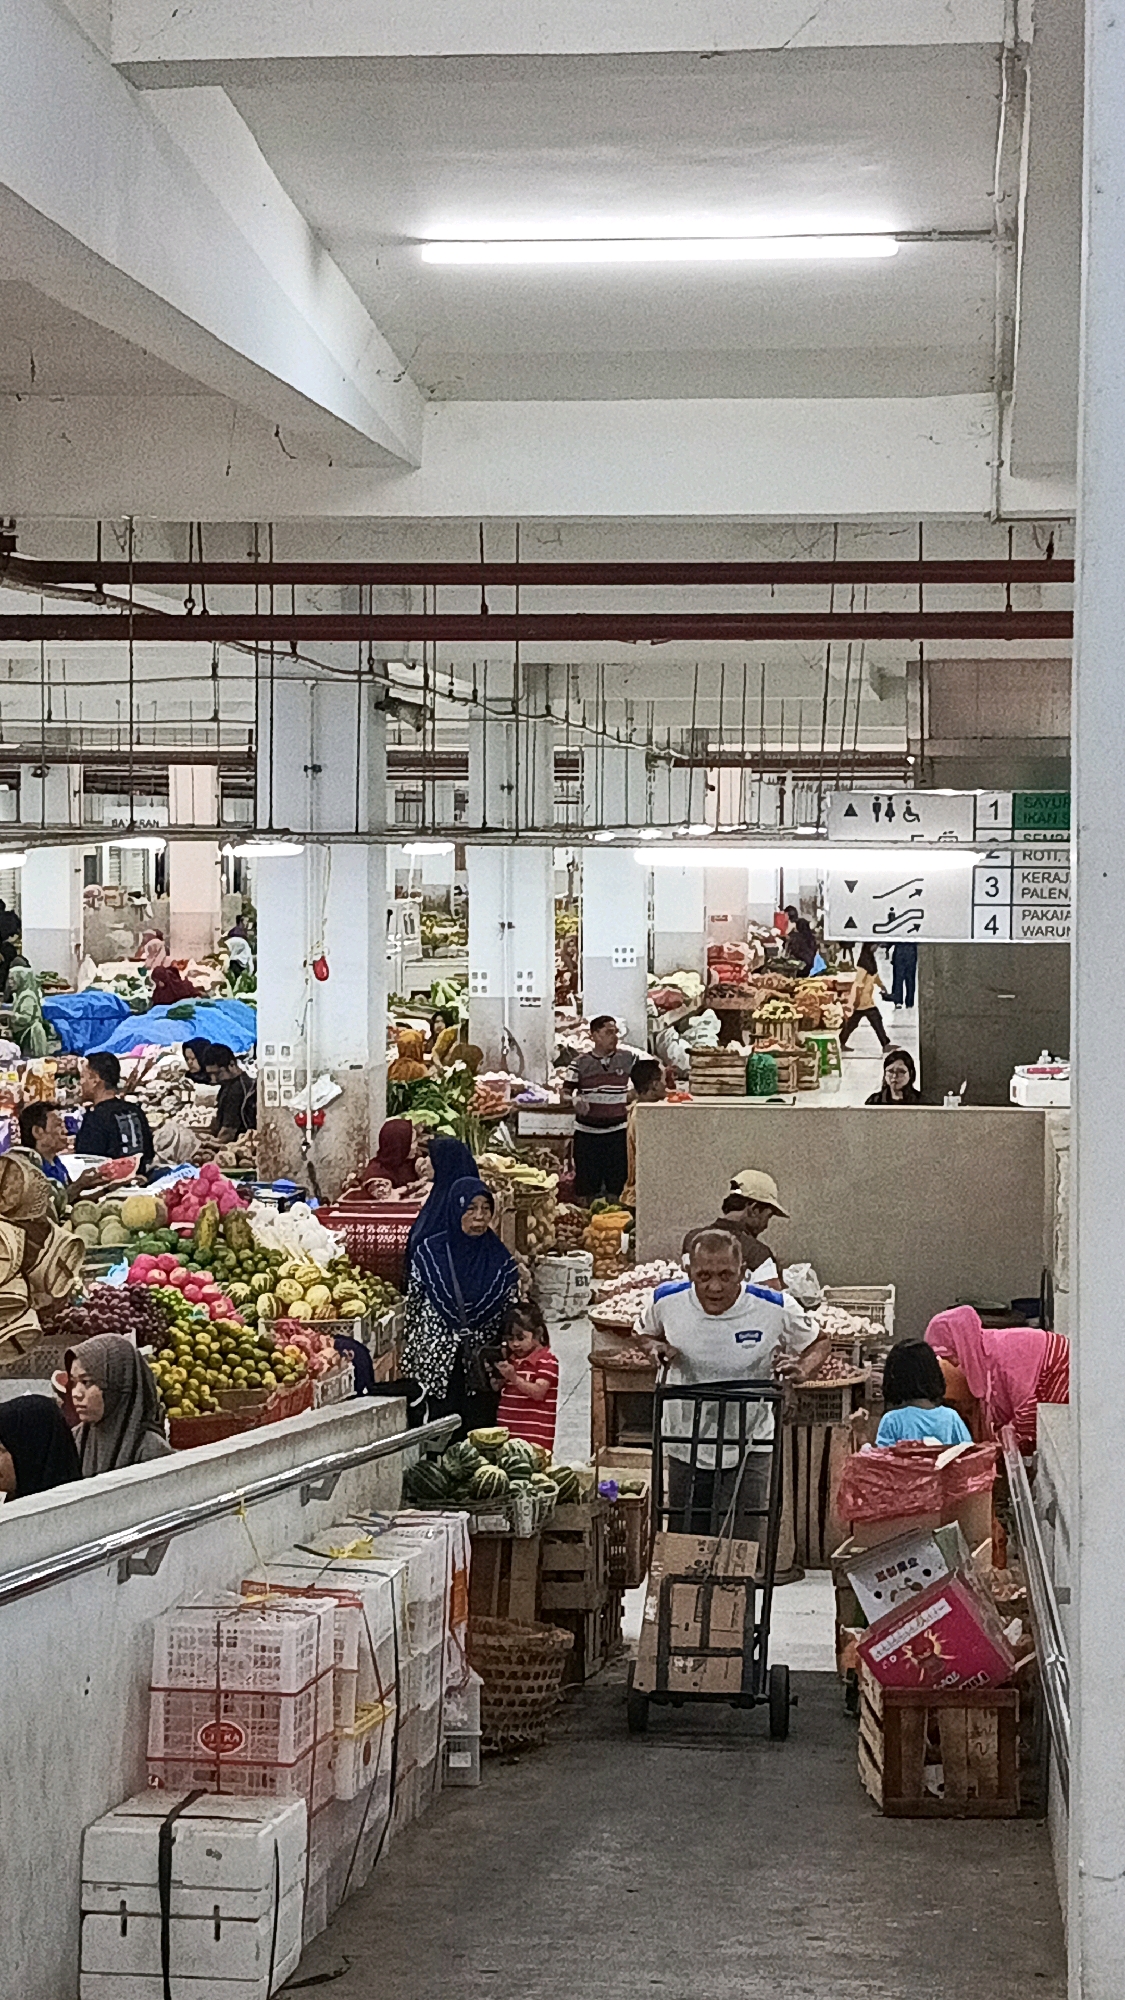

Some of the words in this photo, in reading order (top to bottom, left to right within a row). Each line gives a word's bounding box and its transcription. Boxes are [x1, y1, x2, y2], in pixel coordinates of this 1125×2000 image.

[989, 799, 999, 821] 1
[984, 876, 1000, 898] 3
[984, 914, 999, 936] 4
